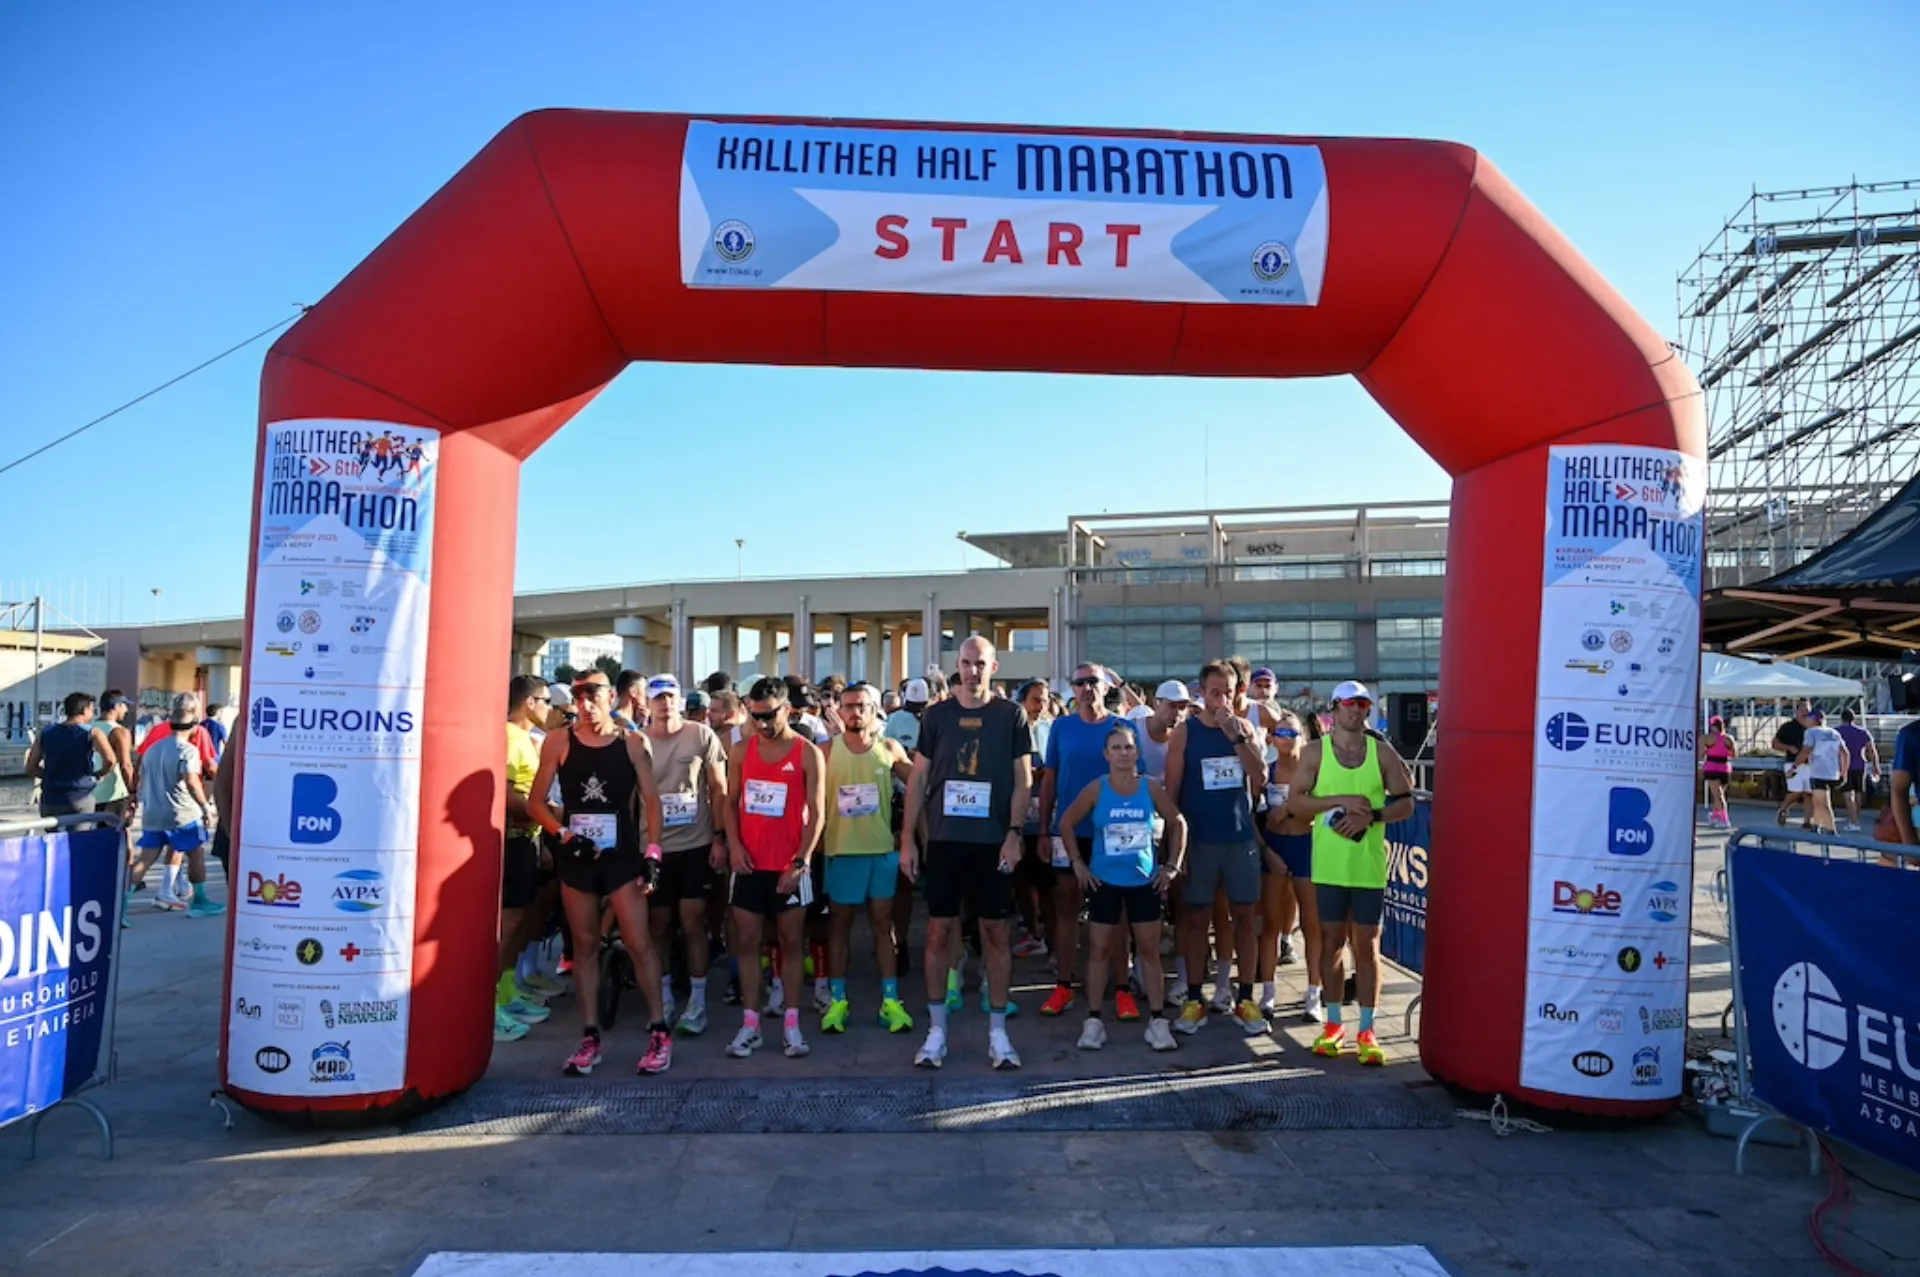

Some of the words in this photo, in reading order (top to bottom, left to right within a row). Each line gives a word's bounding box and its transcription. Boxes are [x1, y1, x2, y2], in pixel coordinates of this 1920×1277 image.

[717, 136, 897, 177] KALLITHEA
[917, 146, 997, 182] HALF
[1016, 143, 1293, 200] MARATHON
[874, 214, 1141, 268] START
[274, 430, 363, 455] KALLITHEA
[272, 455, 307, 479] HALF
[334, 459, 360, 477] 6th
[1565, 456, 1664, 481] KALLITHEA
[1563, 481, 1612, 504] HALF
[1642, 487, 1664, 503] 6th
[269, 479, 418, 532] MARATHON
[1562, 505, 1697, 559] MARATHON
[283, 708, 414, 733] EUROINS
[1595, 723, 1694, 751] EUROINS
[956, 794, 977, 805] 164
[297, 816, 333, 831] FON
[1615, 829, 1647, 843] FON
